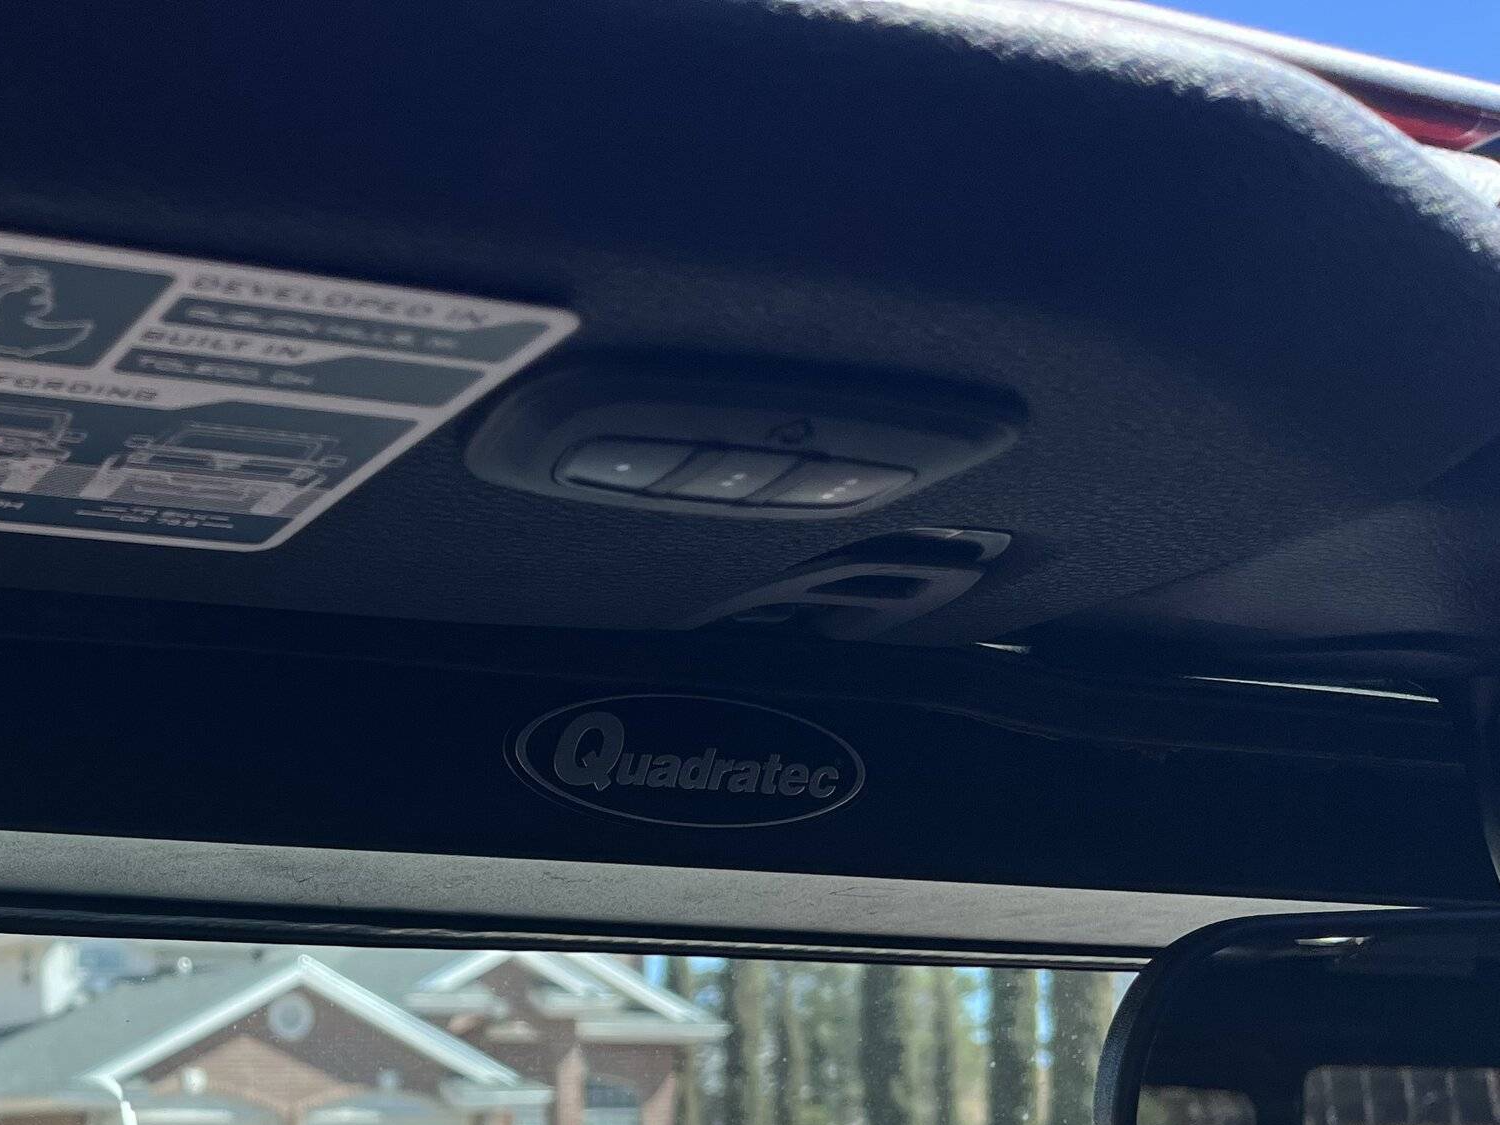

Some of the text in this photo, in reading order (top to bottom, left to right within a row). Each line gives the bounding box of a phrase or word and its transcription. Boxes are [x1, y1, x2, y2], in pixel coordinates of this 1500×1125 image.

[192, 272, 436, 319] DEVELOPED
[141, 327, 251, 351] BUILT
[263, 343, 305, 360] IN
[553, 710, 841, 799] Quadratec
